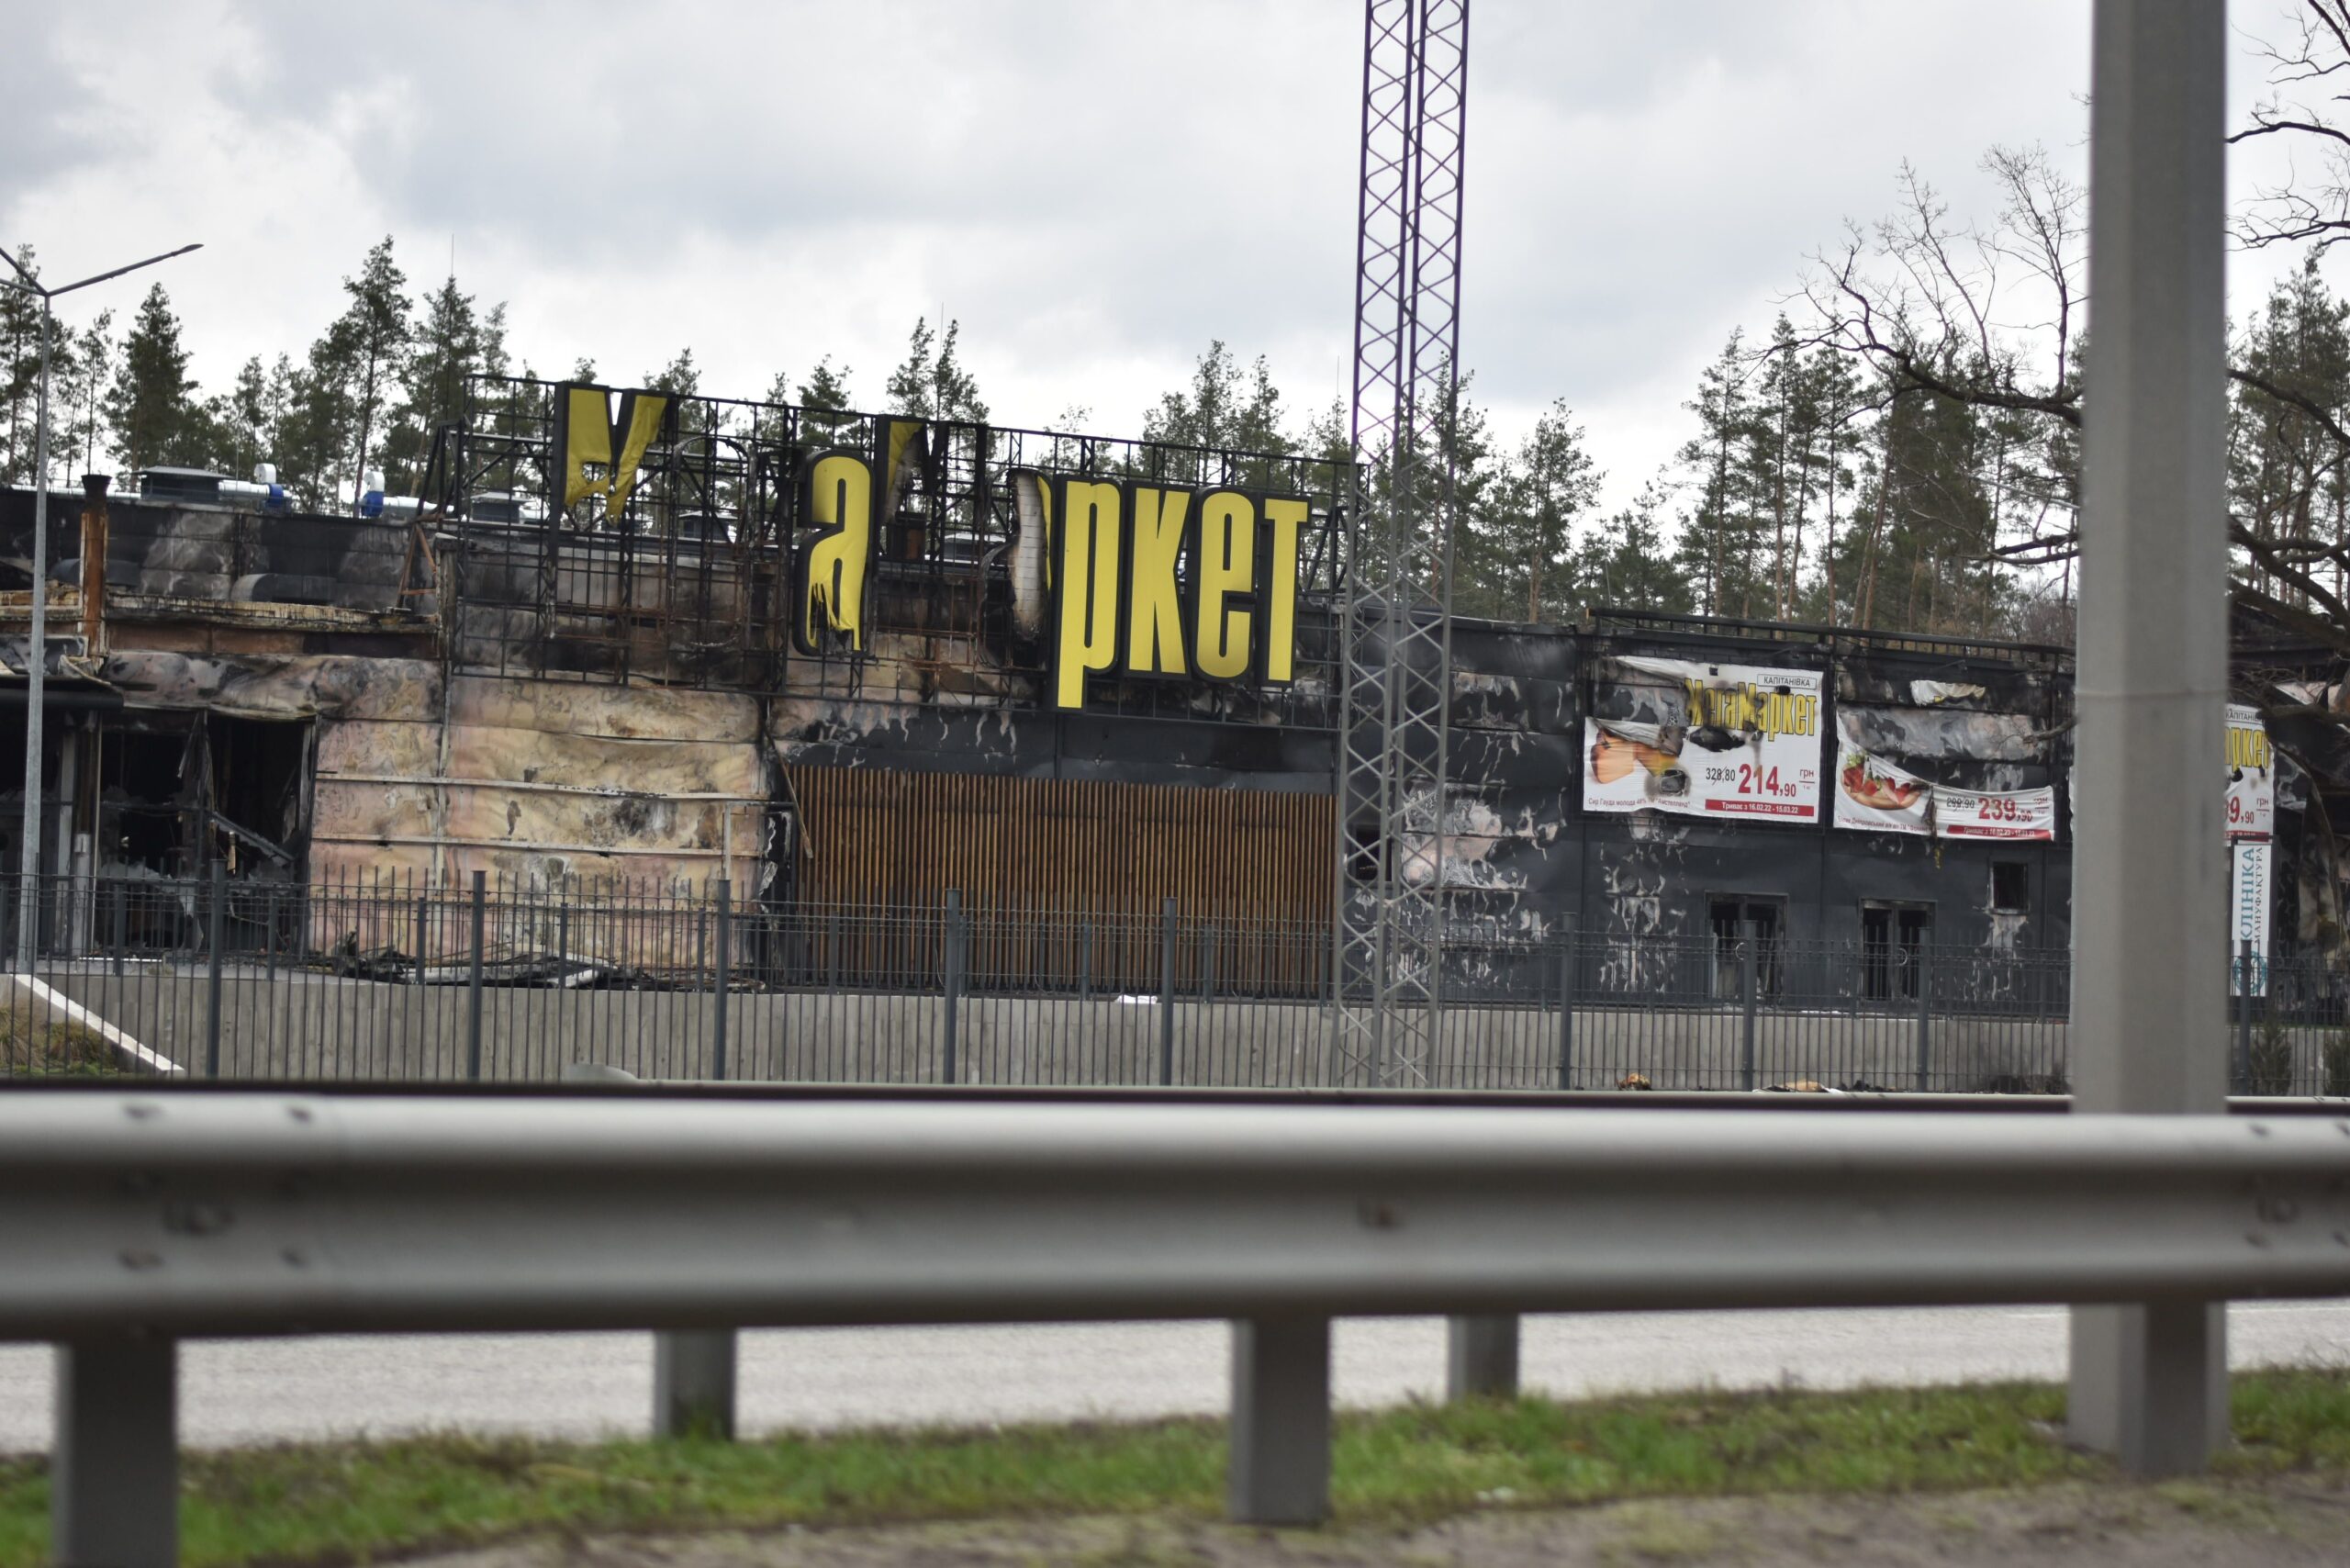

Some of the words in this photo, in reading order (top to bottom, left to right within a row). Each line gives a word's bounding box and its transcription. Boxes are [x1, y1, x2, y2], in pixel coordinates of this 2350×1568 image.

[1763, 676, 1811, 688] КАПІТАНІВКА
[1706, 767, 1736, 783] 328,80
[1799, 768, 1815, 779] грн
[1737, 763, 1797, 798] 214,90
[1749, 802, 1772, 812] 16.02.22
[1776, 804, 1799, 814] 15.03.22
